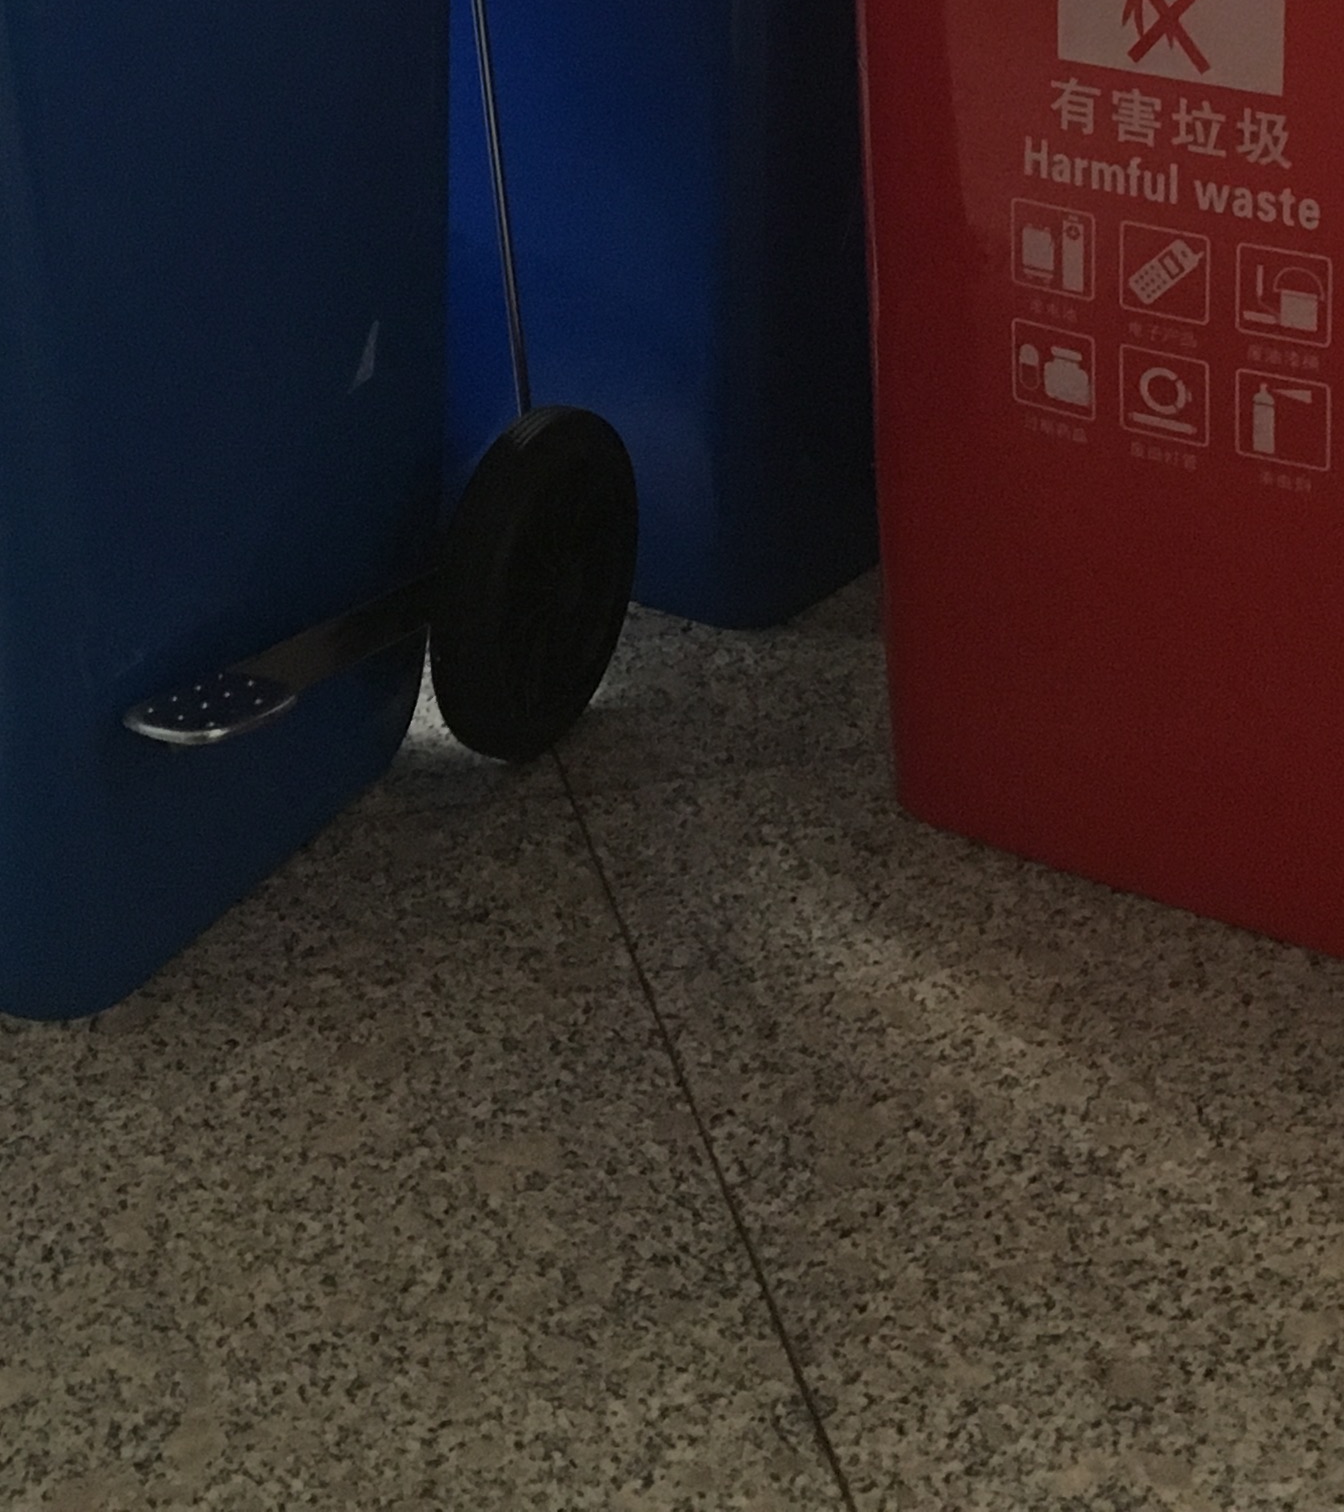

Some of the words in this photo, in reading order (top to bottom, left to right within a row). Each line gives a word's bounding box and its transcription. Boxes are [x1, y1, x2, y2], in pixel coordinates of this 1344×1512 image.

[1050, 79, 1291, 169] 有害垃圾
[1025, 137, 1178, 204] Harmful
[1195, 179, 1320, 230] waste
